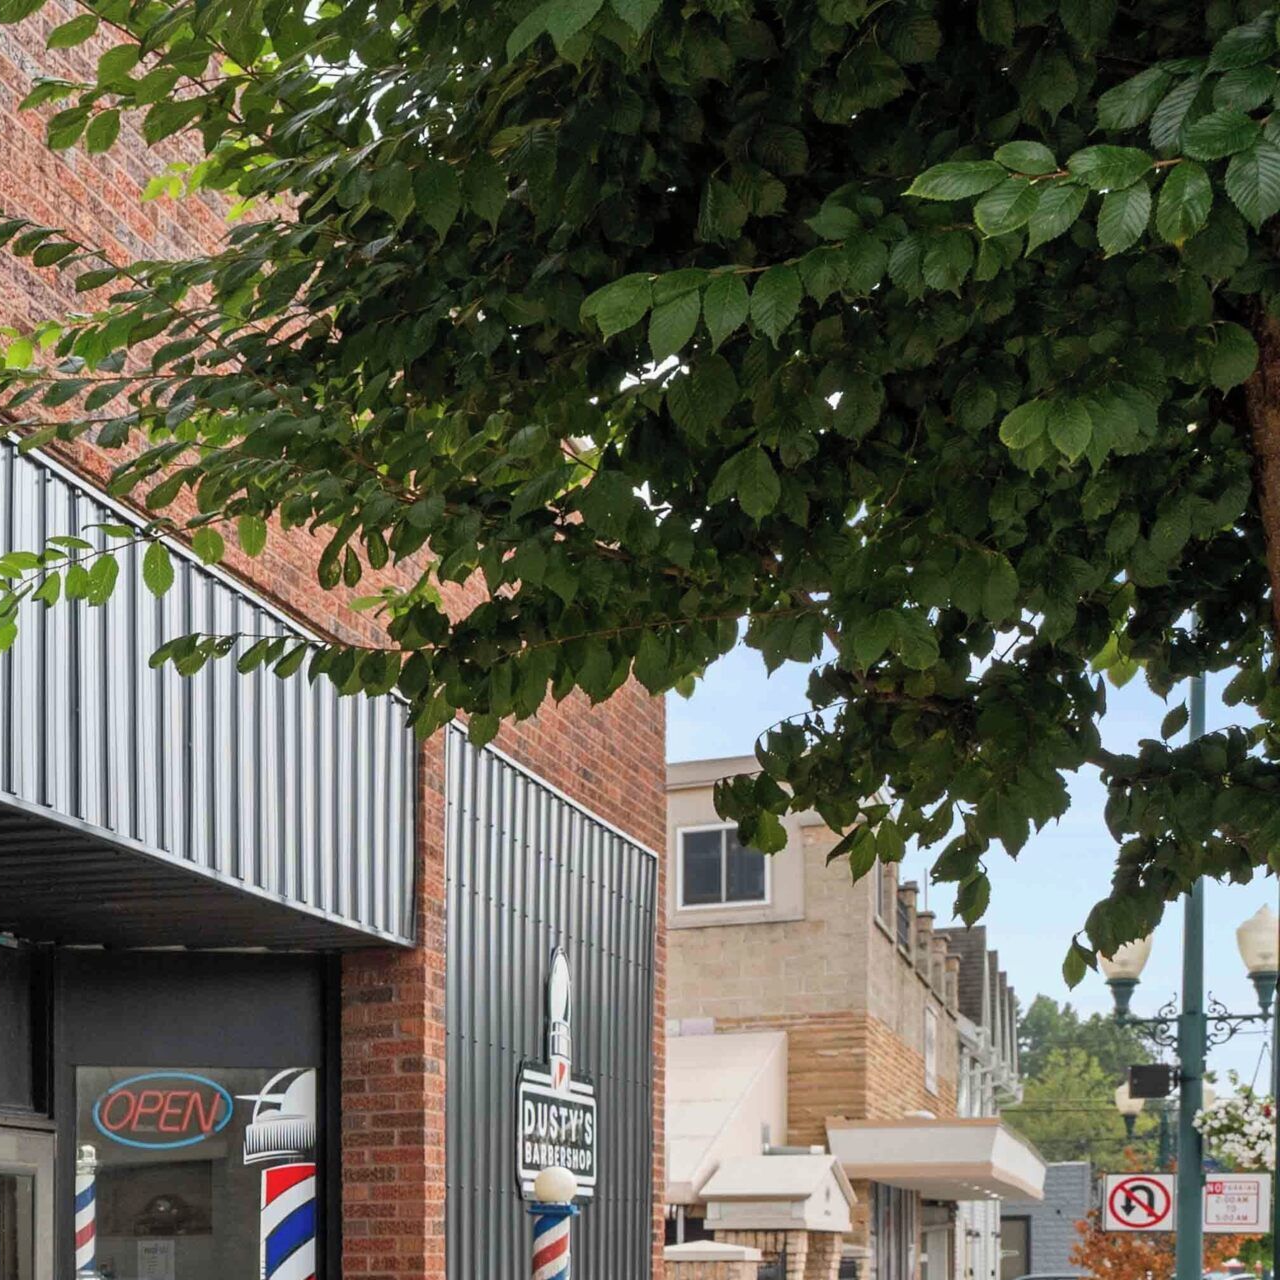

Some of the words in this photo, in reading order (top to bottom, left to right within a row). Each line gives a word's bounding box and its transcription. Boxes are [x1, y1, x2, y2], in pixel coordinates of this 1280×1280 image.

[101, 1089, 222, 1133] OPEN
[523, 1100, 593, 1145] DUSTY'S
[524, 1141, 592, 1170] BARBERSHOP
[1206, 1183, 1222, 1193] NO
